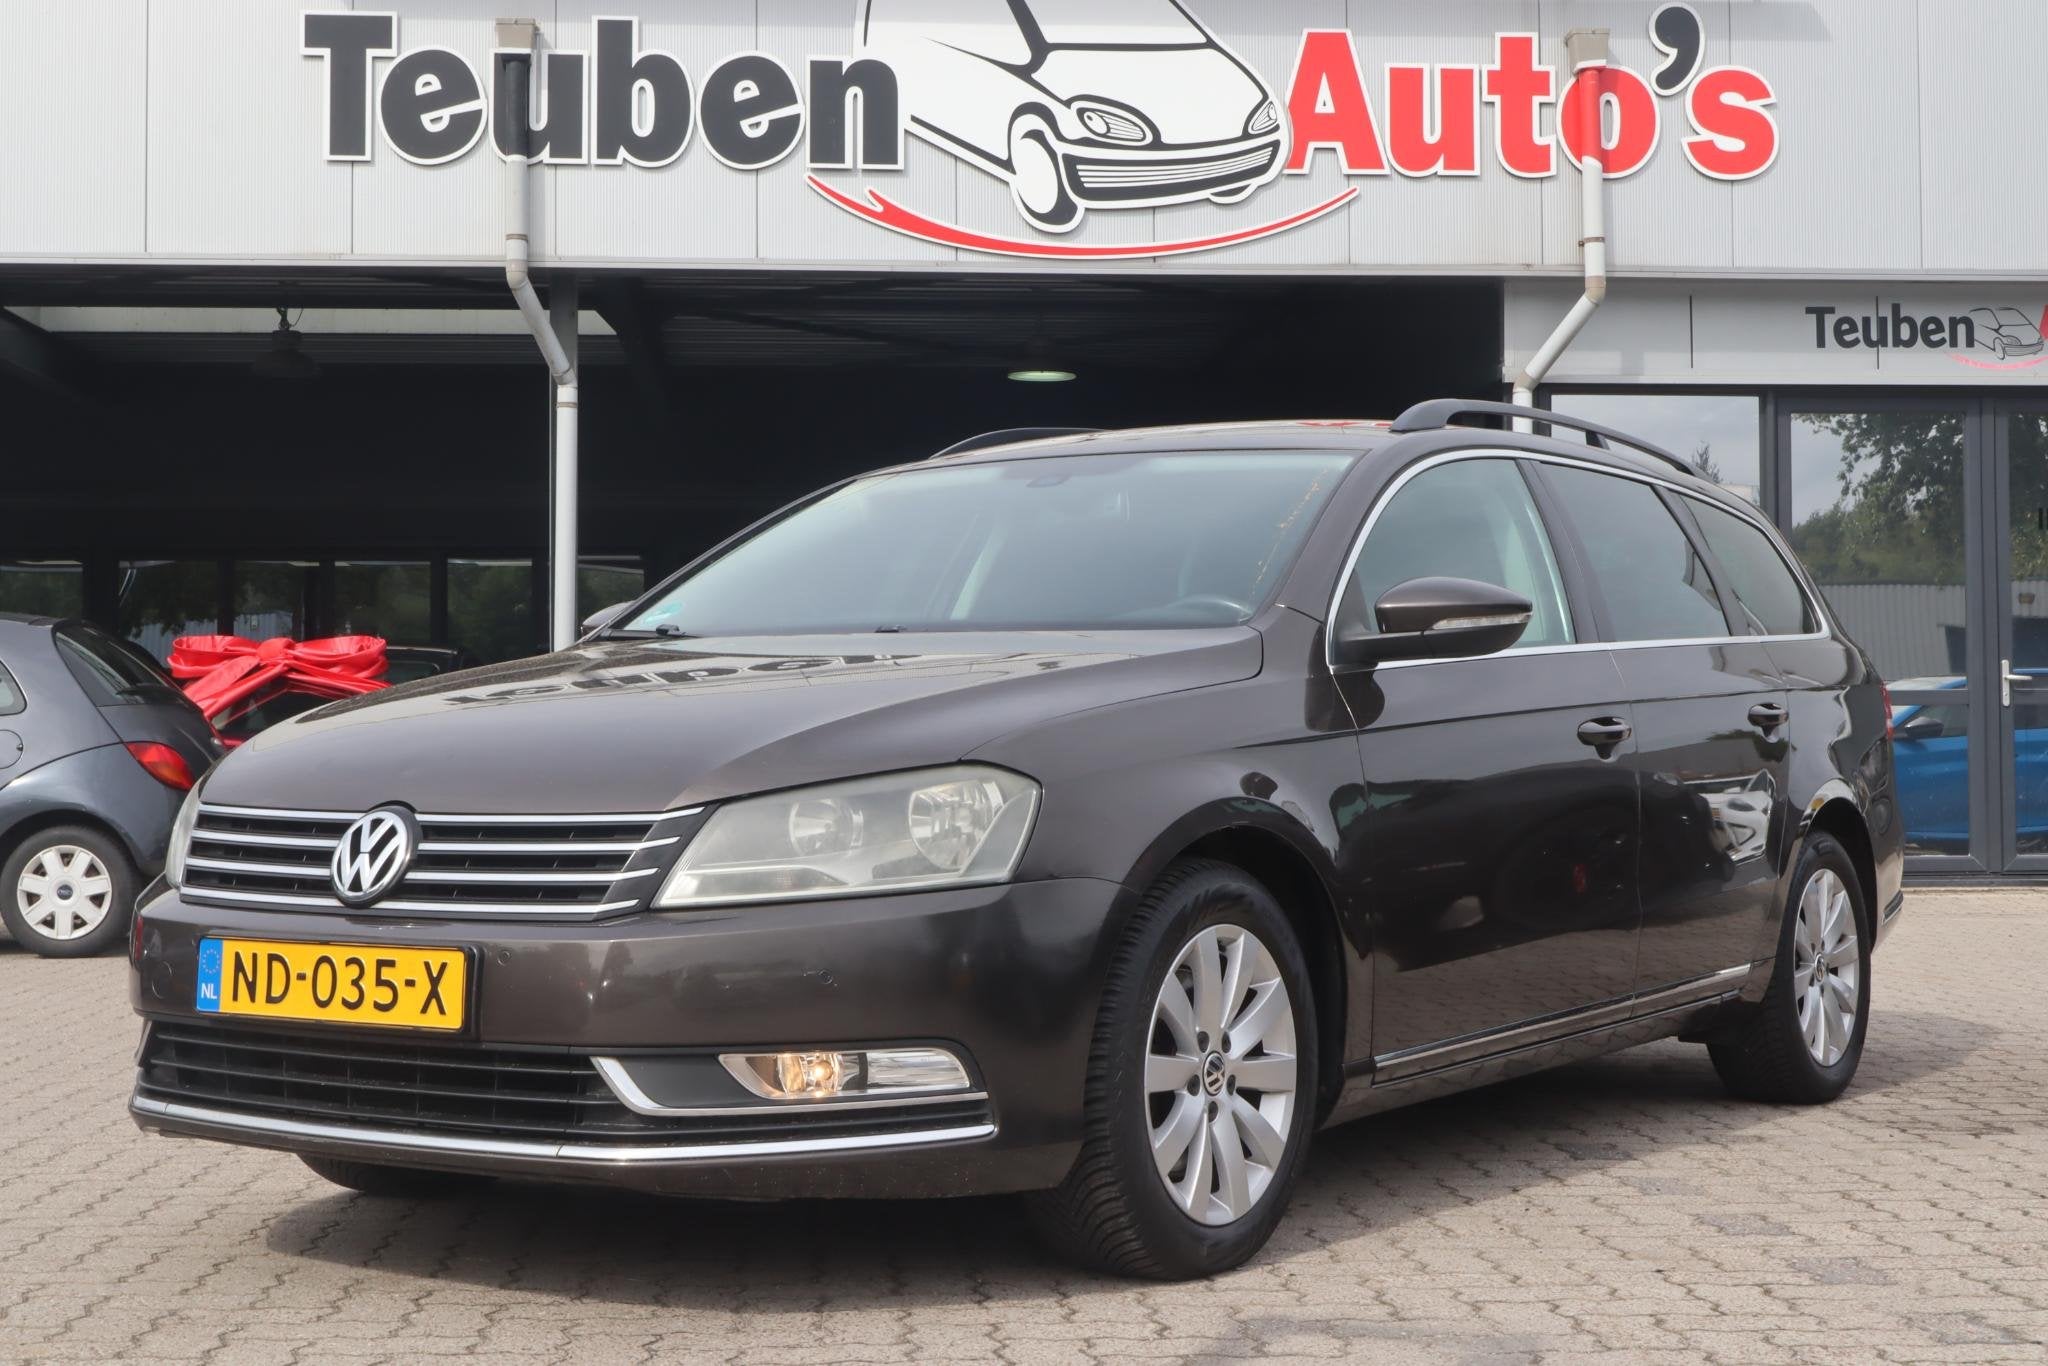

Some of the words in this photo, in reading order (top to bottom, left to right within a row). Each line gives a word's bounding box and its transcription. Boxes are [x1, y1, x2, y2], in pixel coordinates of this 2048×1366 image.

[302, 13, 901, 168] Teuben
[1286, 4, 1777, 178] Auto's
[1805, 303, 1975, 349] Teuben
[200, 982, 218, 1000] NL
[231, 951, 448, 1016] ND-035-X
